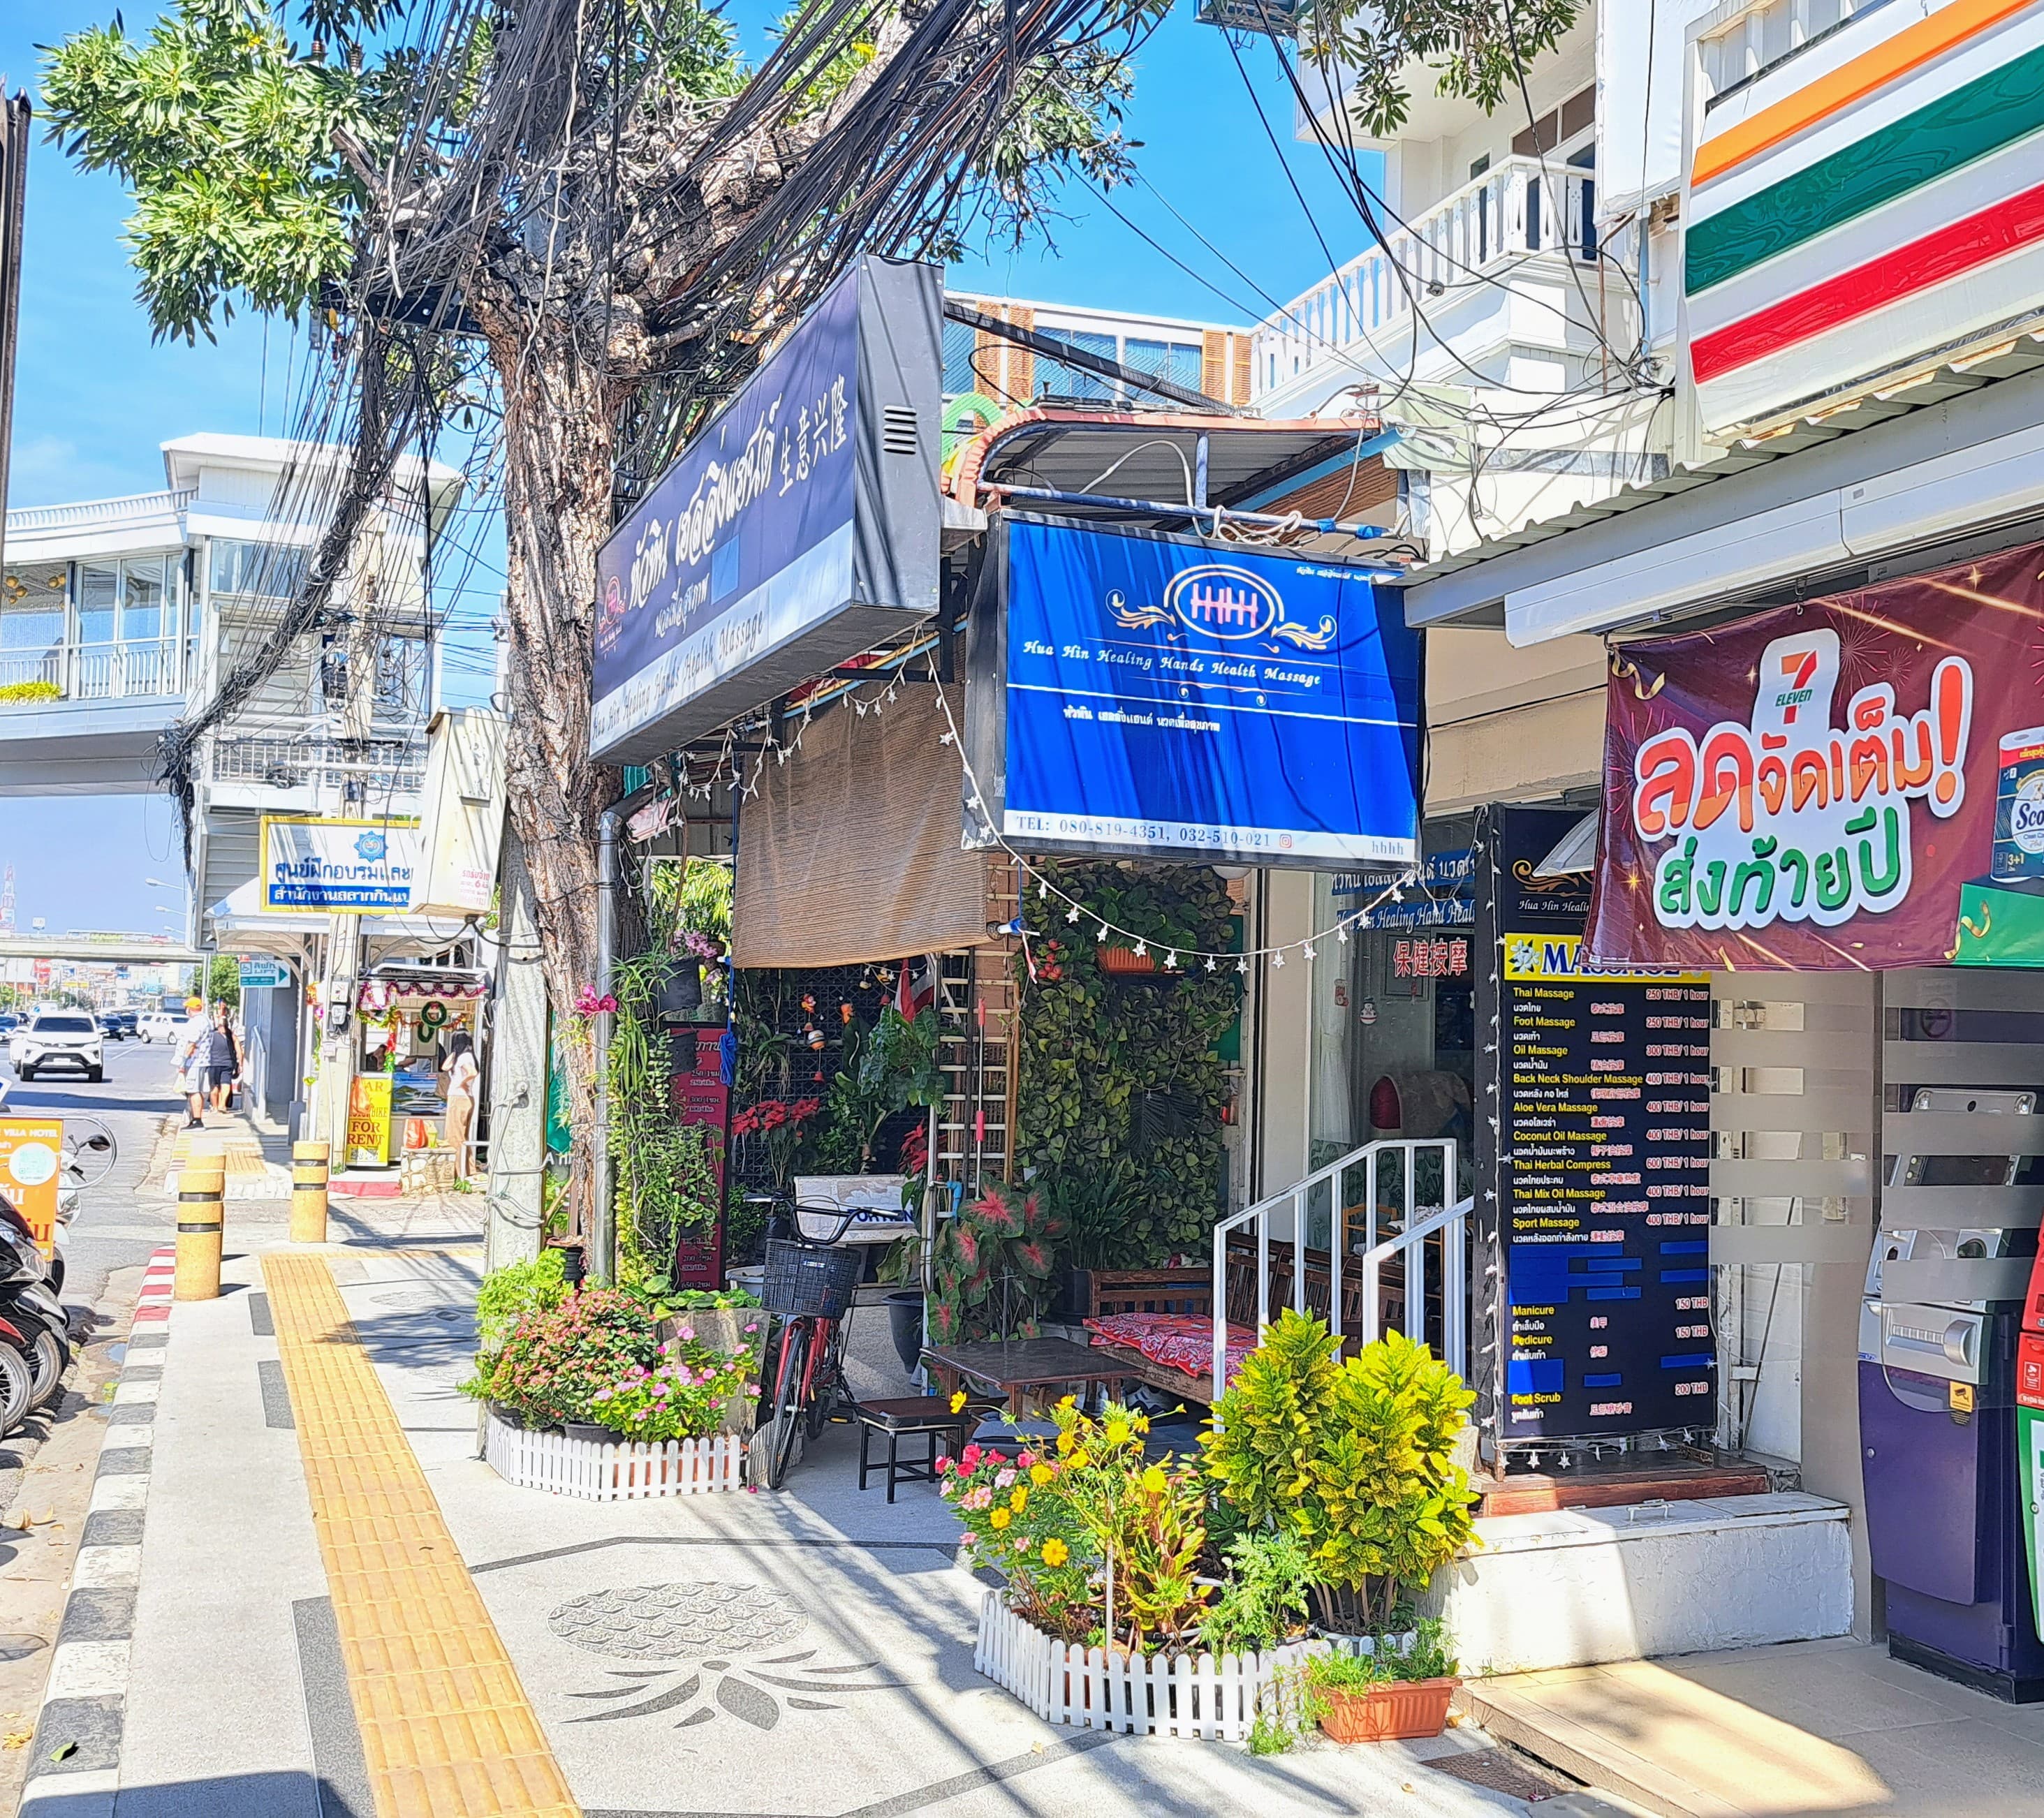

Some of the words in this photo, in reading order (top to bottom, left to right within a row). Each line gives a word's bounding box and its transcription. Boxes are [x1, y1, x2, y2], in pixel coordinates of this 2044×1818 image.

[779, 373, 848, 497] 生意兴隆
[683, 631, 714, 682] Health
[719, 610, 763, 660] Massage
[1023, 641, 1054, 656] Hua
[1061, 644, 1089, 660] Hin
[1096, 649, 1152, 671] Healing
[1159, 656, 1204, 672] Hands
[1210, 662, 1257, 679] Health
[1264, 667, 1321, 687] Massage
[1781, 650, 1817, 725] 7
[1638, 665, 1963, 834] ลดจัดเต็ม!
[1017, 815, 1050, 831] TEL:
[1059, 819, 1170, 843] 080-819-4351,
[1179, 827, 1271, 847] 032-510-021
[1659, 806, 1901, 915] ส่งท้ายปี
[2008, 854, 2025, 866] 3+1
[274, 857, 414, 884] ศูนย์ฝึกอบรมและ
[1518, 899, 1538, 911] Hua
[1541, 901, 1559, 911] Hin
[1376, 906, 1416, 934] Healing
[1393, 938, 1467, 977] 保健按摩
[1513, 987, 1532, 997] Thai
[1535, 988, 1575, 1000] Massage
[1646, 989, 1662, 1000] 250
[1683, 989, 1689, 1000] 1
[1690, 989, 1709, 1000] hour
[1513, 1002, 1541, 1012] นวดไทย
[1514, 1016, 1534, 1026] Foot
[1536, 1017, 1575, 1028] Massage
[1646, 1017, 1662, 1028] 250
[1683, 1017, 1689, 1028] 1
[1690, 1017, 1709, 1028] hour
[1513, 1031, 1540, 1041] นวดเท้า
[1513, 1045, 1525, 1054] Oil
[1528, 1045, 1568, 1057] Massage
[1683, 1045, 1689, 1056] 1
[1690, 1045, 1709, 1056] hour
[1513, 1074, 1536, 1083] Back
[1538, 1074, 1560, 1083] Neck
[1562, 1074, 1601, 1084] Shoulder
[1604, 1074, 1642, 1086] Massage
[1646, 1072, 1662, 1085] 400
[1683, 1073, 1689, 1084] 1
[1690, 1073, 1709, 1085] hour
[363, 1081, 383, 1091] AR
[1513, 1102, 1534, 1111] Aloe
[1536, 1102, 1557, 1111] Vera
[1558, 1102, 1598, 1114] Massage
[1646, 1100, 1662, 1113] 400
[1683, 1101, 1689, 1112] 1
[1690, 1101, 1709, 1113] hour
[3, 1128, 27, 1137] VILLA
[29, 1128, 58, 1137] HOTEL
[352, 1121, 380, 1133] FOR
[347, 1133, 385, 1145] RENT
[1513, 1131, 1552, 1141] Coconut
[1553, 1131, 1565, 1141] Oil
[1568, 1131, 1607, 1142] Massage
[1646, 1128, 1662, 1141] 400
[1683, 1129, 1689, 1140] 1
[1690, 1129, 1709, 1141] hour
[1513, 1160, 1533, 1169] Thai
[1535, 1160, 1564, 1169] Herbal
[1566, 1160, 1611, 1171] Compress
[1683, 1158, 1689, 1168] 1
[1690, 1158, 1709, 1169] hour
[1513, 1189, 1532, 1199] Thai
[1535, 1189, 1550, 1198] Mix
[1552, 1189, 1564, 1198] Oil
[1566, 1189, 1605, 1199] Massage
[1646, 1185, 1662, 1197] 400
[1683, 1185, 1689, 1197] 1
[1690, 1185, 1709, 1197] hour
[1513, 1218, 1538, 1230] Sport
[1540, 1218, 1580, 1229] Massage
[1646, 1213, 1662, 1225] 400
[1683, 1213, 1689, 1225] 1
[1690, 1213, 1709, 1225] hour
[1675, 1298, 1691, 1310] 150
[1691, 1296, 1709, 1309] THB
[1513, 1306, 1554, 1317] Manicure
[1691, 1325, 1709, 1337] THB
[1513, 1334, 1552, 1345] Pedicure
[1675, 1383, 1691, 1396] 200
[1512, 1394, 1533, 1405] Foot
[1534, 1392, 1561, 1403] Scrub
